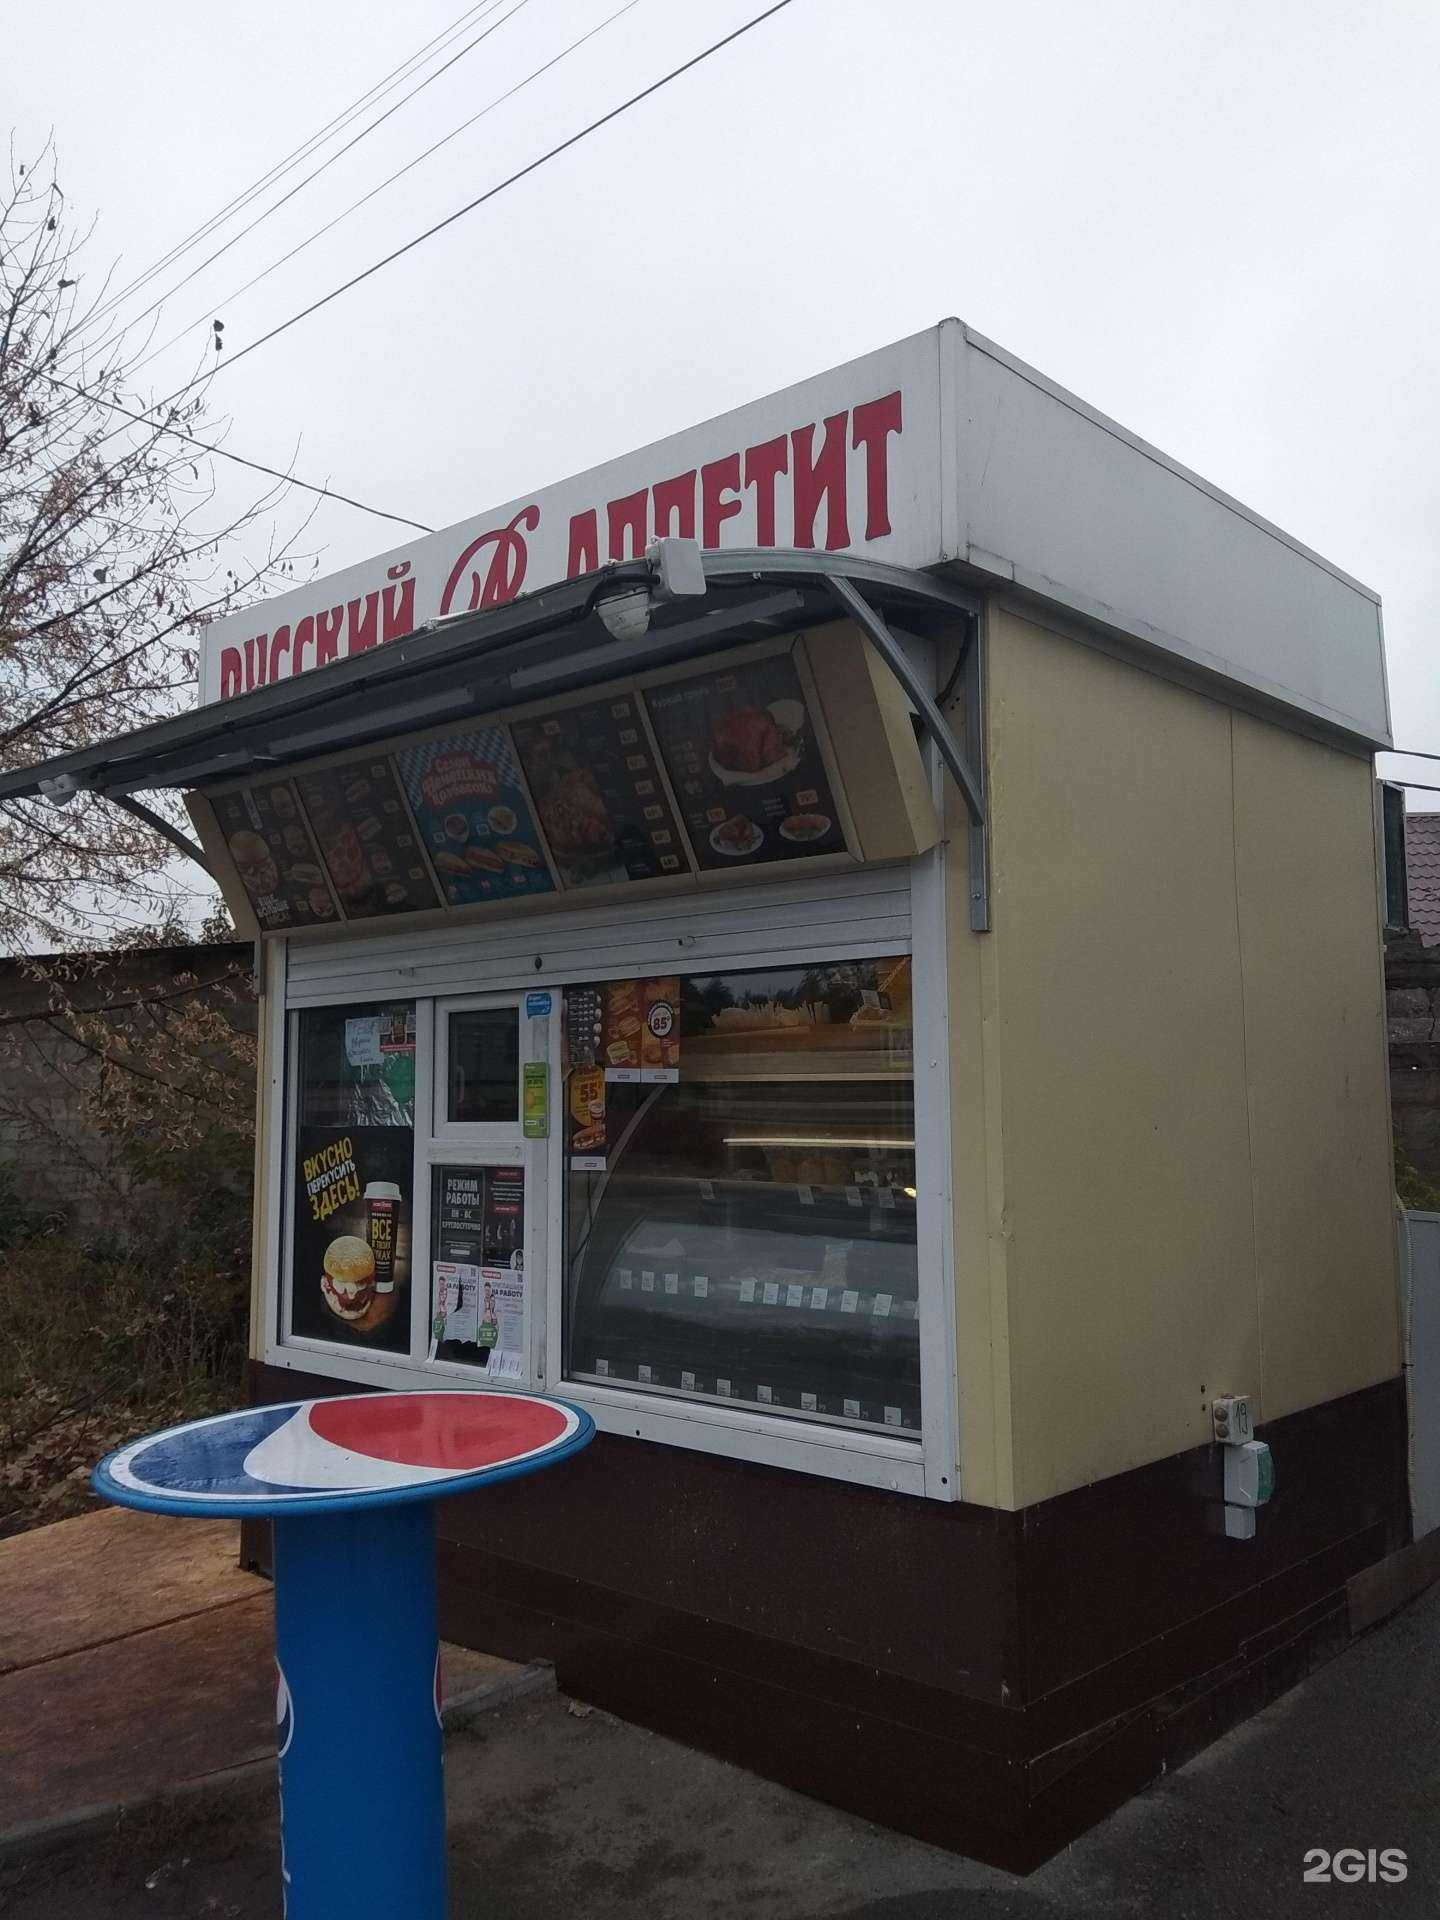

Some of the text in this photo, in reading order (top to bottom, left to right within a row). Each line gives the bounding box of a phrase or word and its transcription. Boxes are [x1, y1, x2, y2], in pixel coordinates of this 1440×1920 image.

[303, 1137, 353, 1181] ВКУСНО
[306, 1158, 356, 1196] ПЕРЕКУСИТЬ
[447, 1178, 478, 1192] РЕЖИМ
[309, 1171, 360, 1221] ЗДЕСЬ!
[446, 1192, 480, 1206] РАБОТЫ
[371, 1218, 392, 1241] ВСЕ
[499, 1289, 523, 1298] РАБОТУ
[1224, 1396, 1248, 1435] 19
